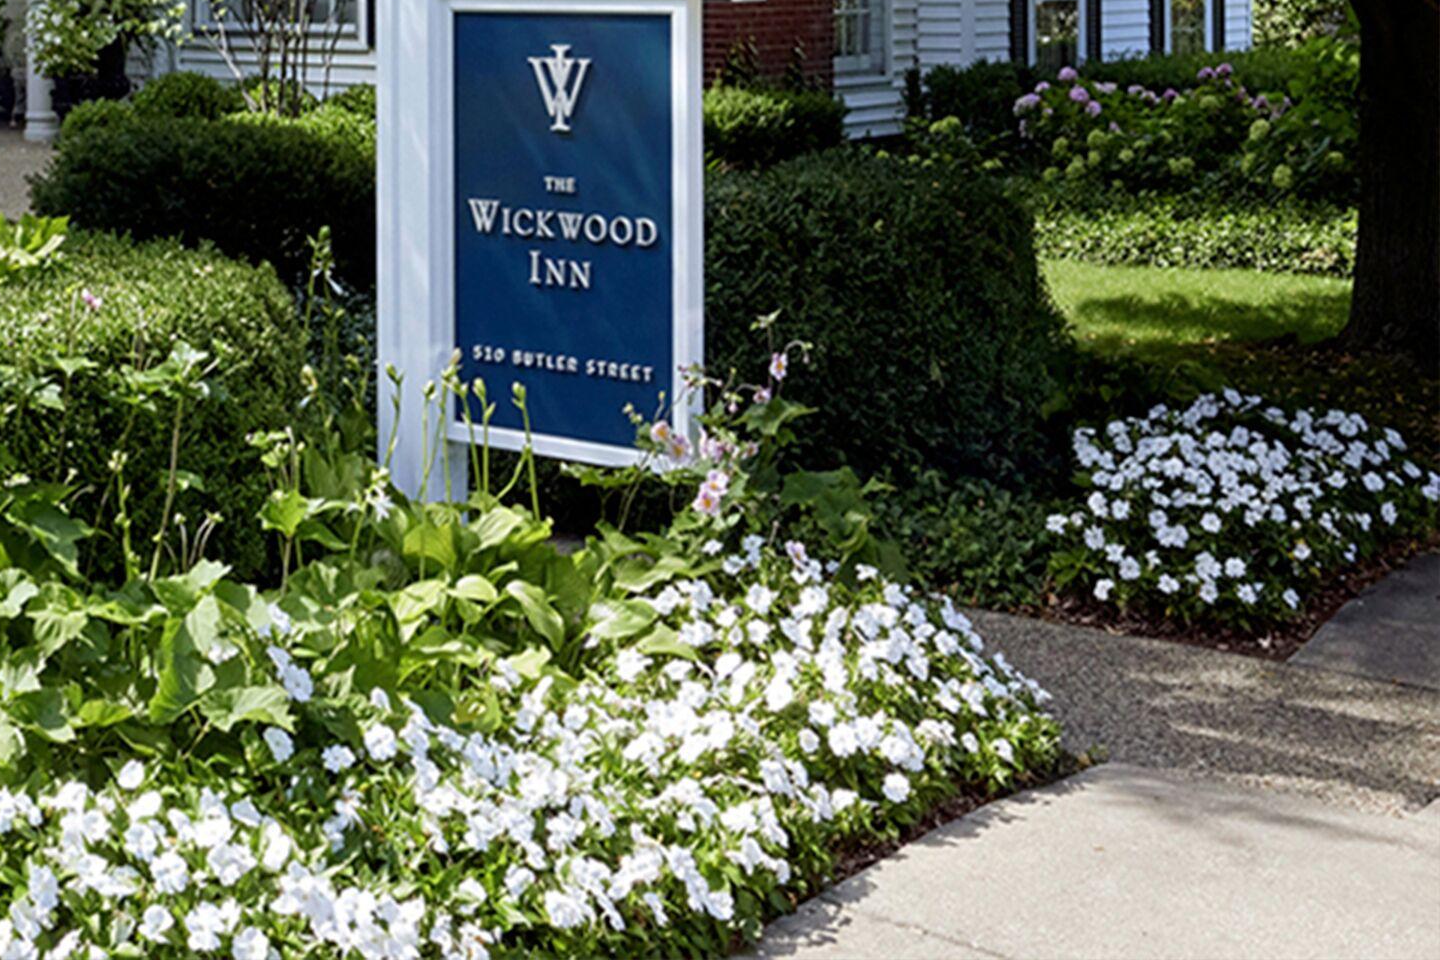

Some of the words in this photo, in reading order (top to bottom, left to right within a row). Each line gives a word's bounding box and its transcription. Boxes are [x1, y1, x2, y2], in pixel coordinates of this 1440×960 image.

[544, 175, 576, 194] THE
[468, 198, 658, 247] WICKWOOD
[529, 251, 592, 289] INN
[512, 350, 578, 373] BUTLER
[585, 358, 654, 382] STREET
